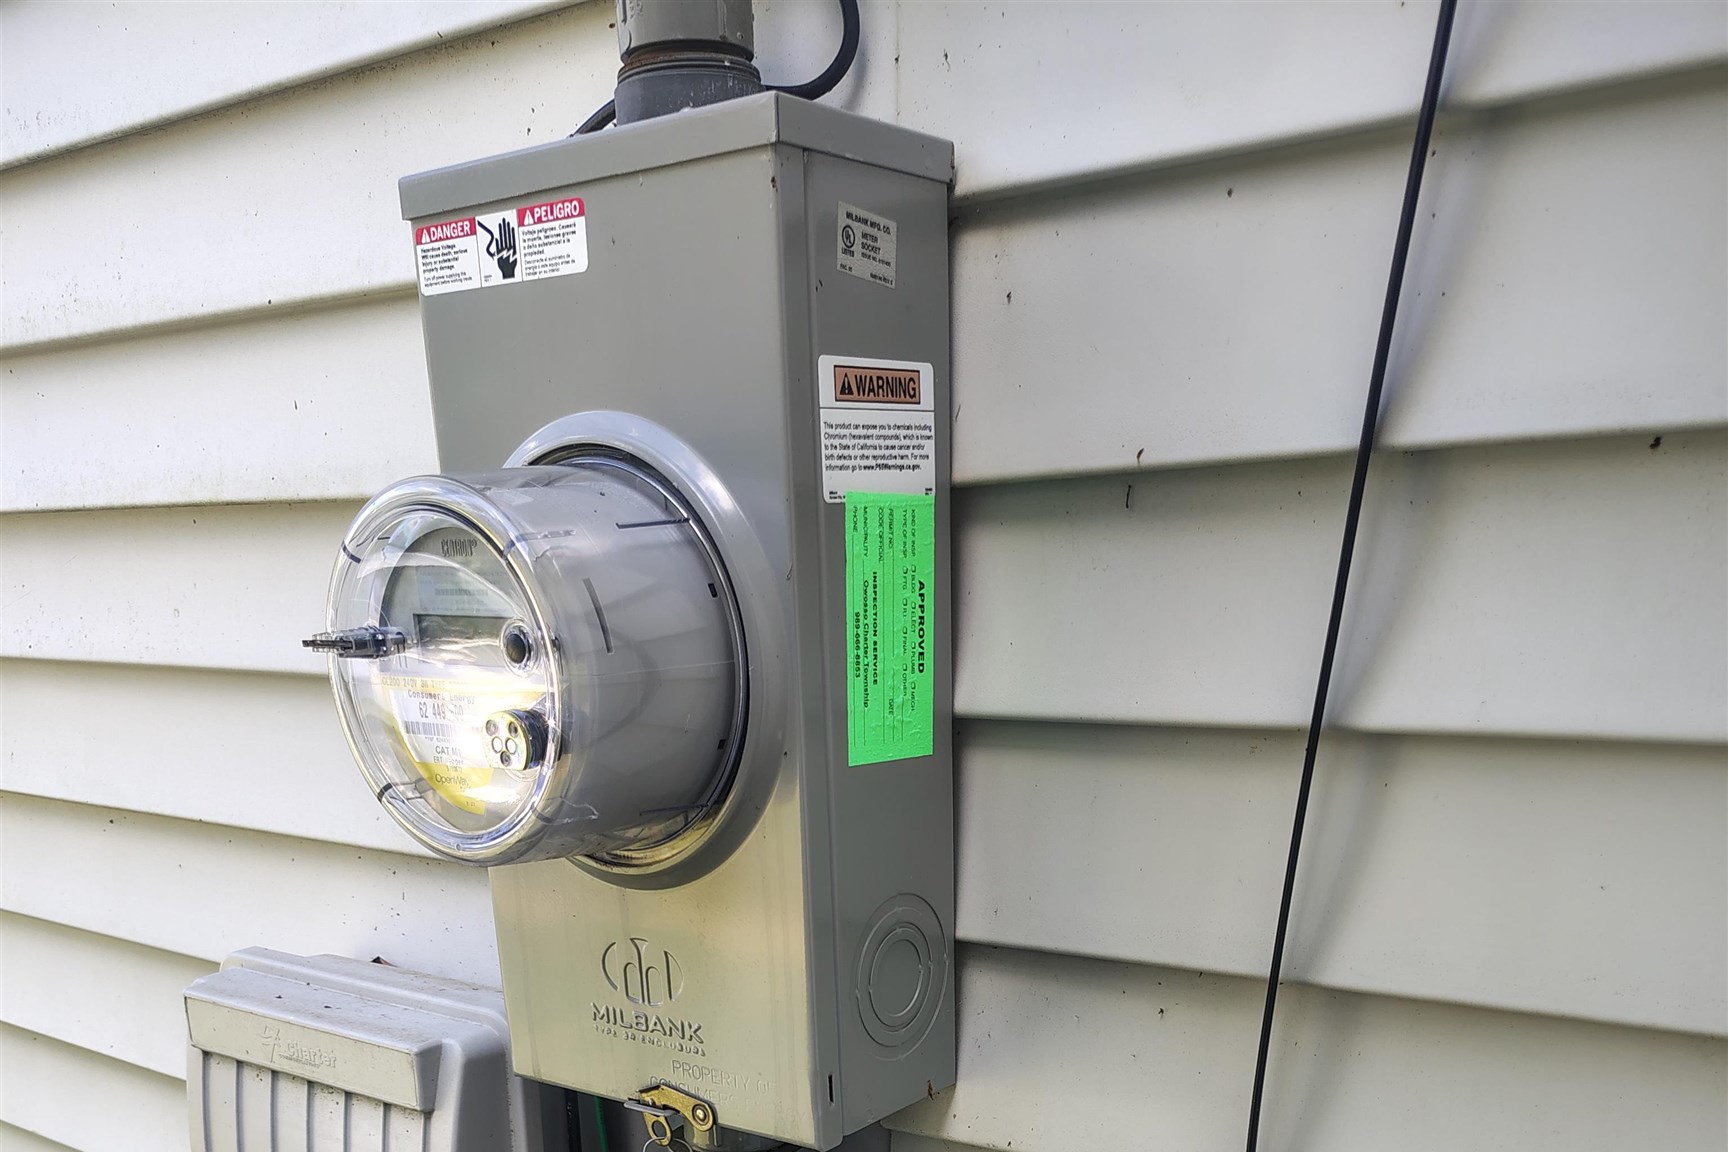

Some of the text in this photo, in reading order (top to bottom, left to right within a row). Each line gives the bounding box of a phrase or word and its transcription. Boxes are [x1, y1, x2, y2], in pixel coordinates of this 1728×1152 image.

[534, 200, 579, 222] PELIGRO
[846, 210, 869, 226] MILBANK
[430, 221, 470, 241] DANGER
[862, 232, 878, 244] METER
[861, 241, 881, 255] SOCKET
[855, 374, 916, 399] WARNING
[835, 422, 852, 431] product
[862, 424, 877, 432] expose
[892, 422, 913, 431] chemicals
[914, 423, 932, 432] including
[824, 432, 848, 441] Chromium
[839, 443, 850, 451] State
[857, 443, 877, 451] California
[419, 702, 428, 718] 62
[436, 745, 449, 756] CAT
[591, 1002, 704, 1044] MILBANK
[288, 1040, 337, 1068] Charter
[671, 1060, 750, 1091] PROPERTY
